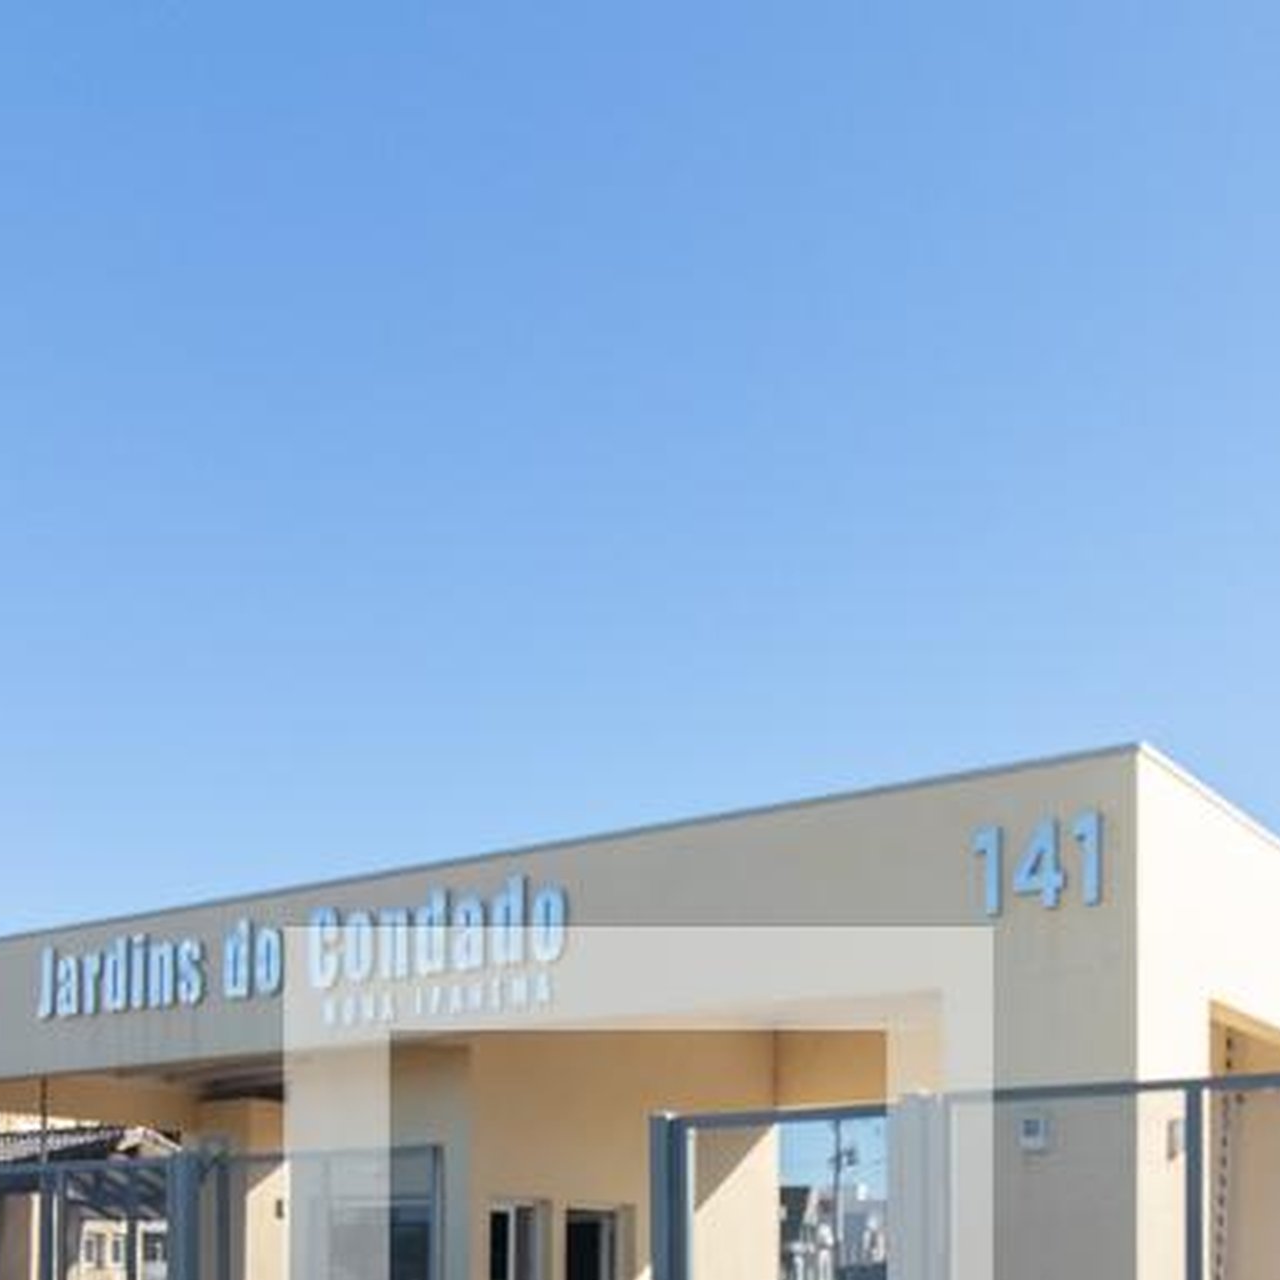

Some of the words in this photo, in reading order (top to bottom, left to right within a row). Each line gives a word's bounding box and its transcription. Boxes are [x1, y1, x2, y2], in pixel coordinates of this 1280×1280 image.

[972, 809, 1104, 917] 141
[37, 932, 206, 1020] Jardins
[224, 919, 284, 1000] do
[308, 875, 570, 989] Condado
